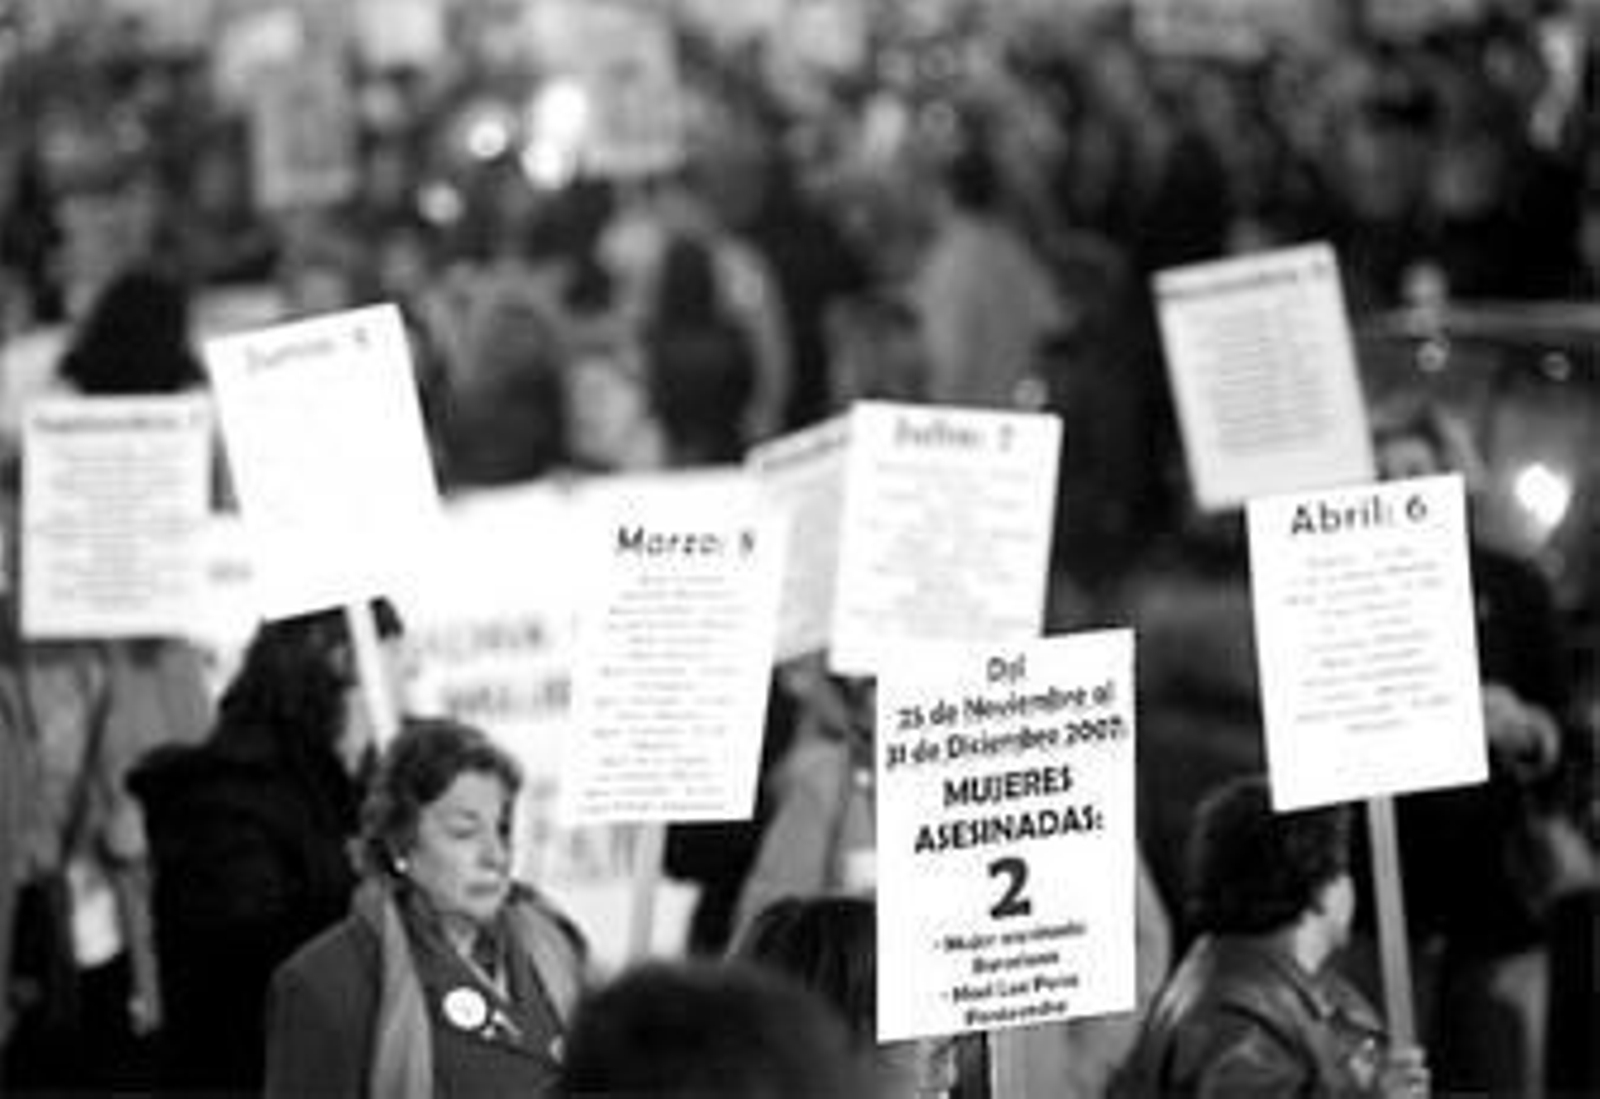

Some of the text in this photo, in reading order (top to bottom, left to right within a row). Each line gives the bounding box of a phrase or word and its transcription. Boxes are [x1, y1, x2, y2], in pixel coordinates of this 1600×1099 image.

[1290, 493, 1429, 536] Abril: 6
[929, 699, 959, 726] de
[964, 684, 1087, 720] Noviembre
[910, 738, 941, 765] de
[947, 725, 1059, 760] Diciembre
[943, 765, 1073, 808] MUJERES
[914, 803, 1104, 854] ASESINADAS:
[988, 857, 1031, 920] 2
